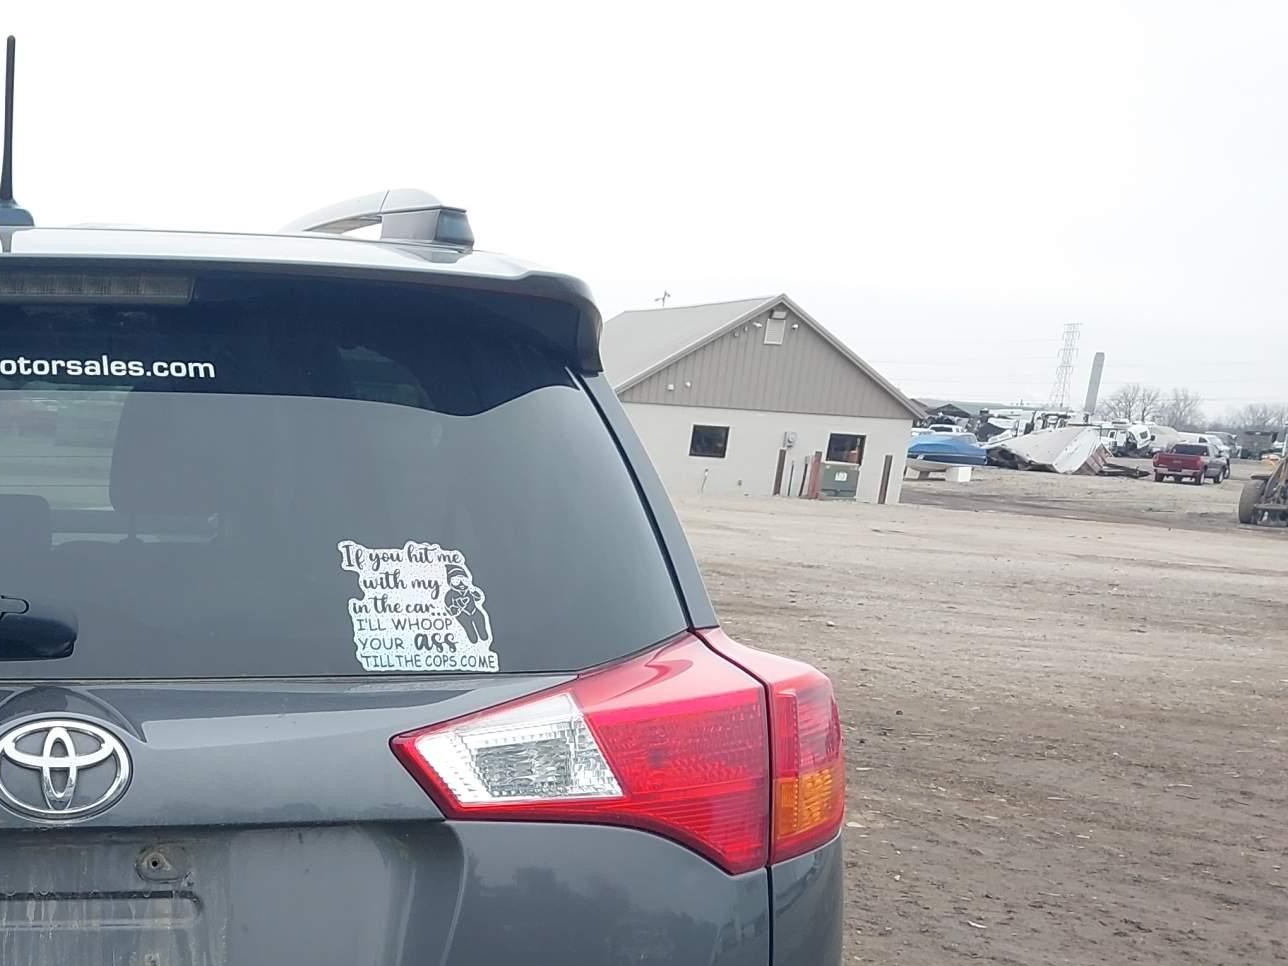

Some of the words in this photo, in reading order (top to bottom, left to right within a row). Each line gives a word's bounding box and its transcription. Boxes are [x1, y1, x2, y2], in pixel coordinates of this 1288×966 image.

[342, 544, 364, 569] If
[369, 552, 404, 571] you
[407, 543, 437, 564] hit
[438, 552, 461, 564] me
[363, 569, 407, 590] with
[411, 578, 441, 599] my
[352, 601, 371, 615] in
[368, 594, 403, 614] the
[357, 618, 386, 631] I'LL
[392, 618, 453, 631] WHOOP
[358, 638, 405, 651] YOUR
[414, 633, 459, 652] ass
[394, 655, 421, 668] THE
[425, 655, 457, 668] COPS
[460, 655, 496, 669] COME
